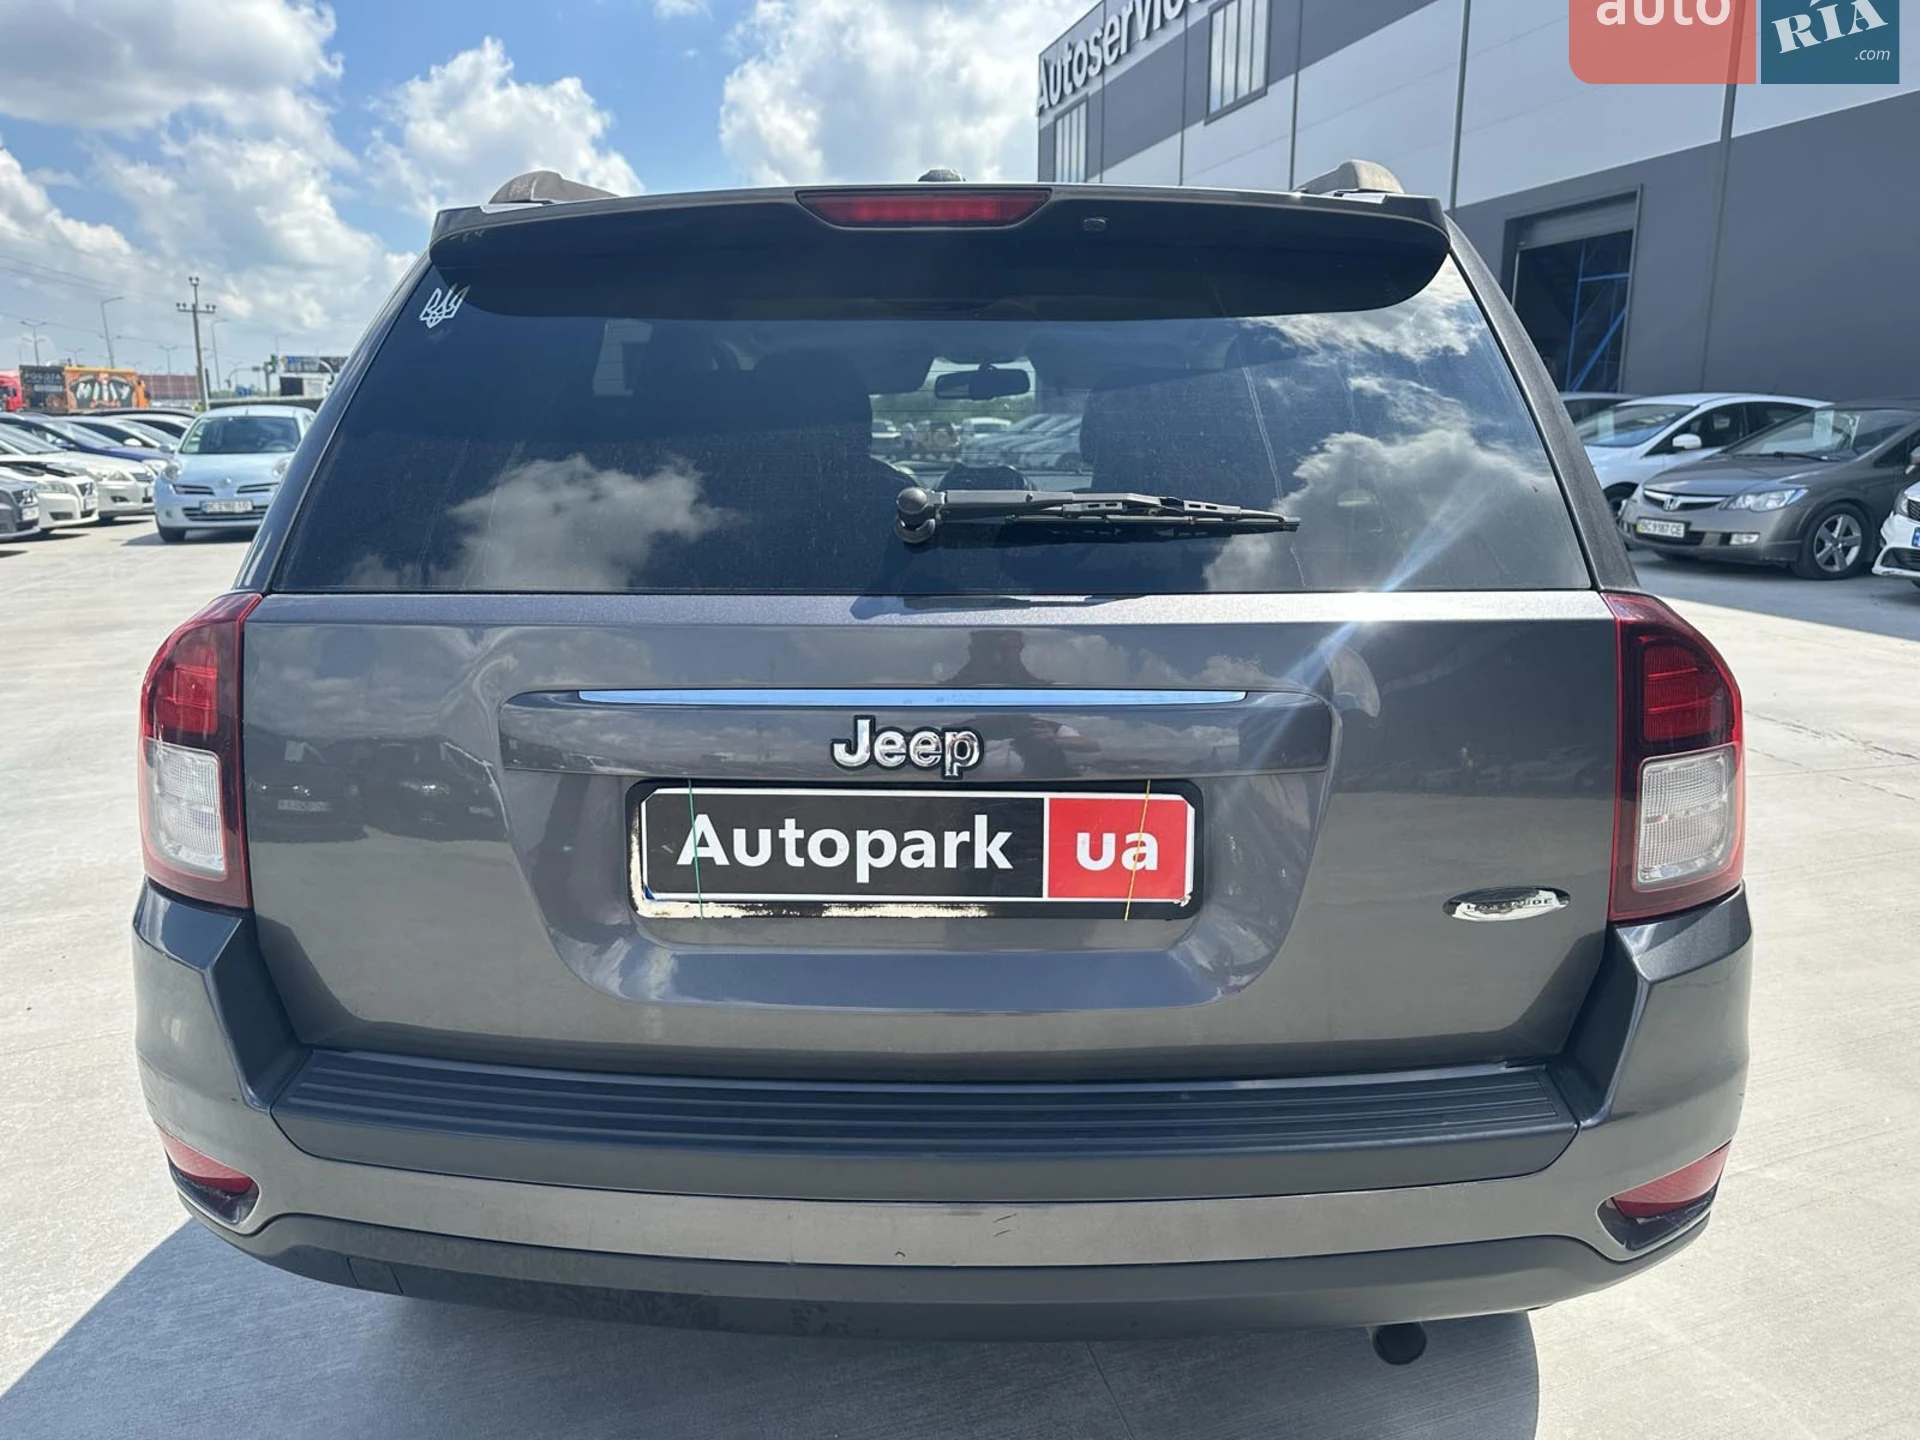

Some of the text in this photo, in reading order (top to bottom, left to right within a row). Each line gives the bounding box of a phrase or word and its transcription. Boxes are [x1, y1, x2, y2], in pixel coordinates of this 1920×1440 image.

[1037, 0, 1205, 113] Autoservi
[832, 716, 984, 777] Jeep
[676, 813, 1158, 884] Autopark ua
